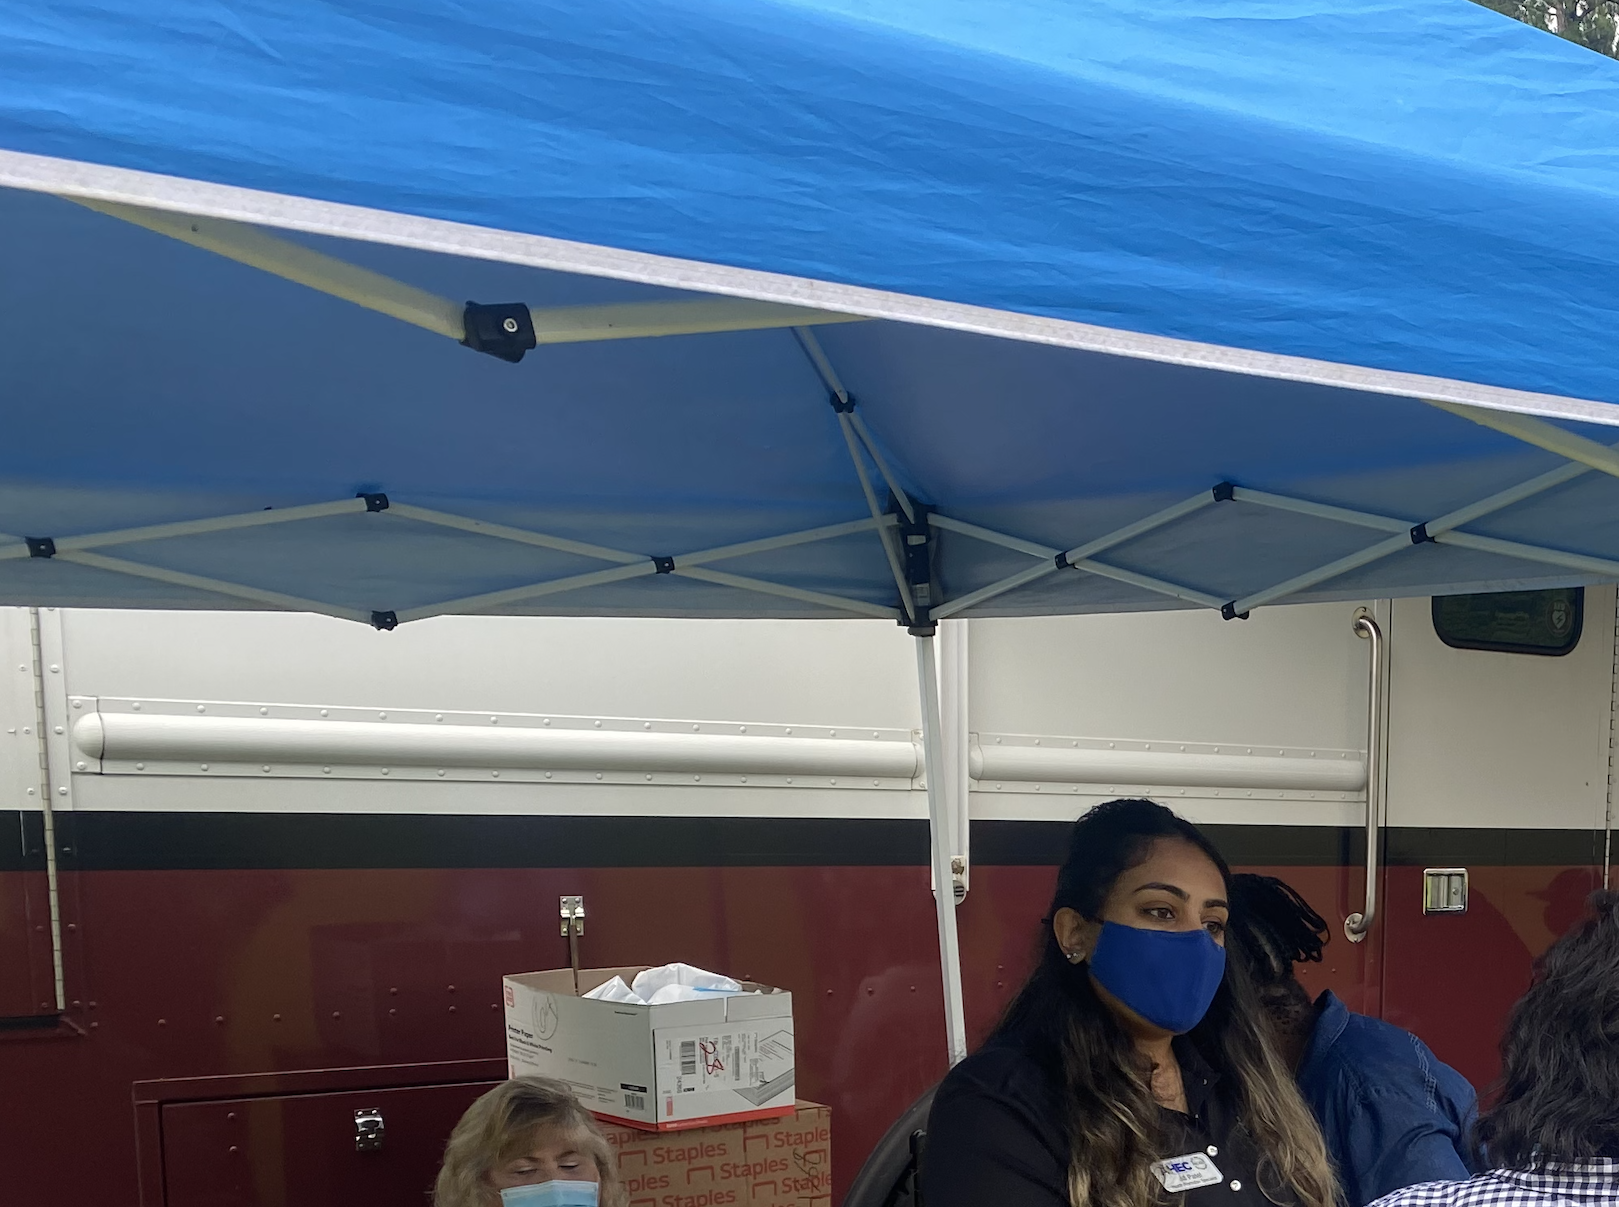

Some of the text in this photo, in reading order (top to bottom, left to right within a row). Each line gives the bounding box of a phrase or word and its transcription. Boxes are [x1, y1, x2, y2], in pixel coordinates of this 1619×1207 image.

[774, 1127, 829, 1148] Staple
[653, 1142, 727, 1165] Staples
[720, 1158, 789, 1180] Staples
[628, 1174, 670, 1196] ples
[782, 1171, 832, 1193] Staple
